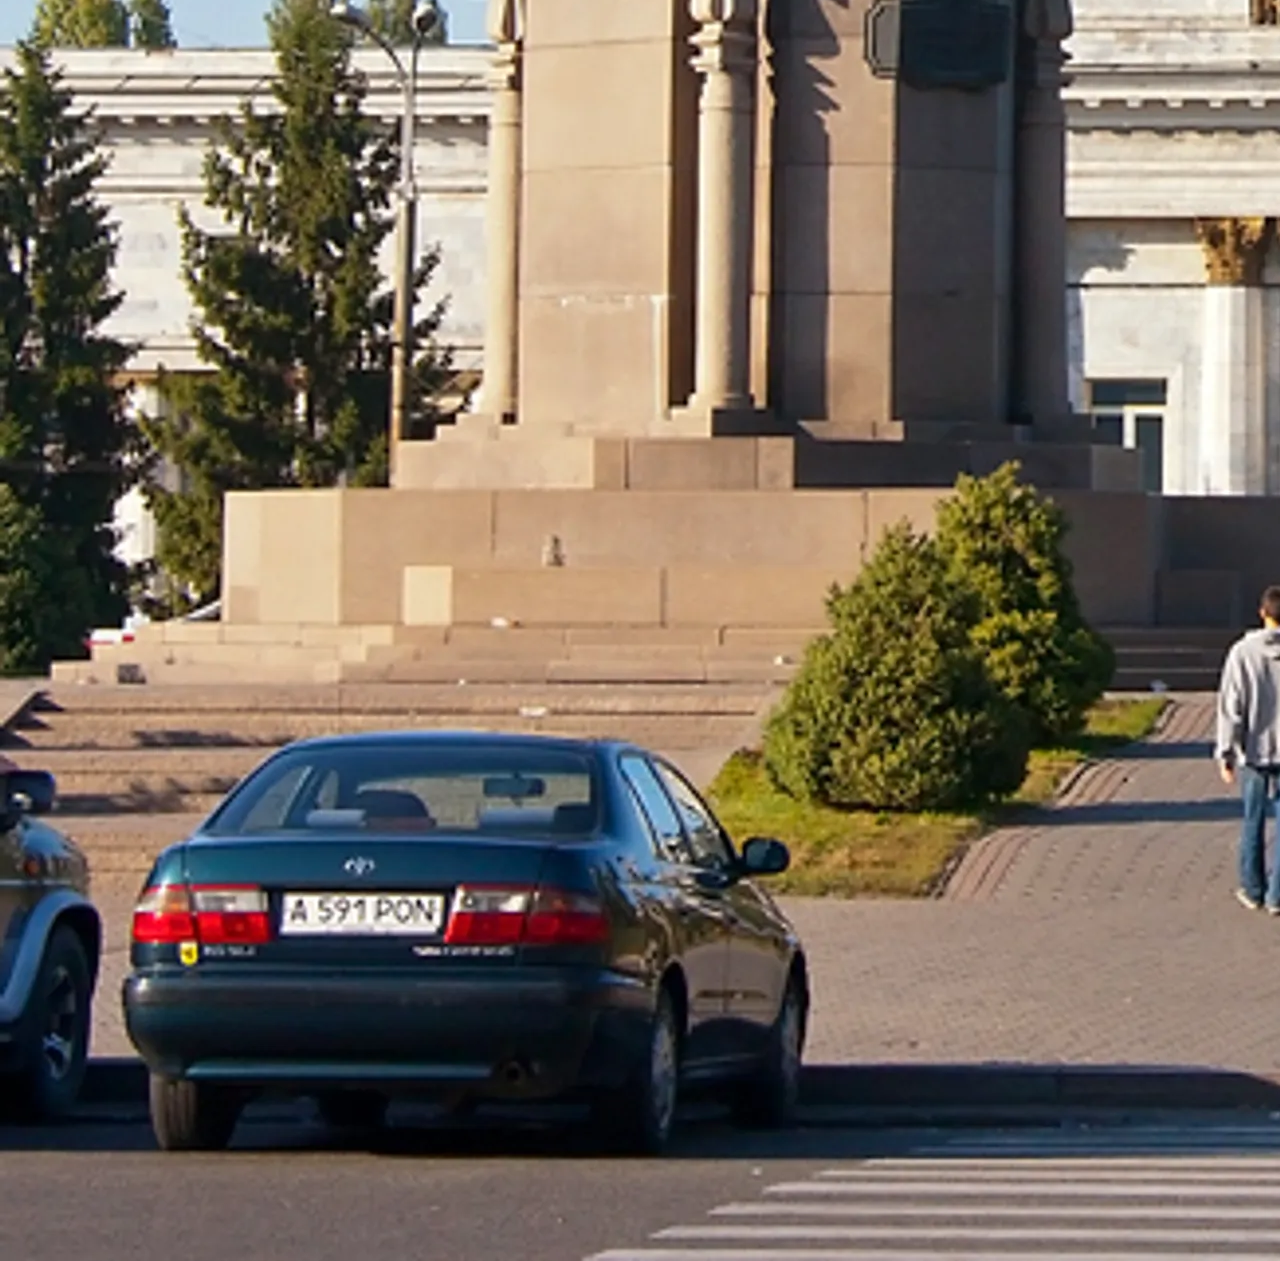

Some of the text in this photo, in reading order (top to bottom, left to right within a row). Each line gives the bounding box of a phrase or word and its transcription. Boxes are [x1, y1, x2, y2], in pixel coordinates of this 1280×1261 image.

[291, 898, 436, 924] A 591 PON
